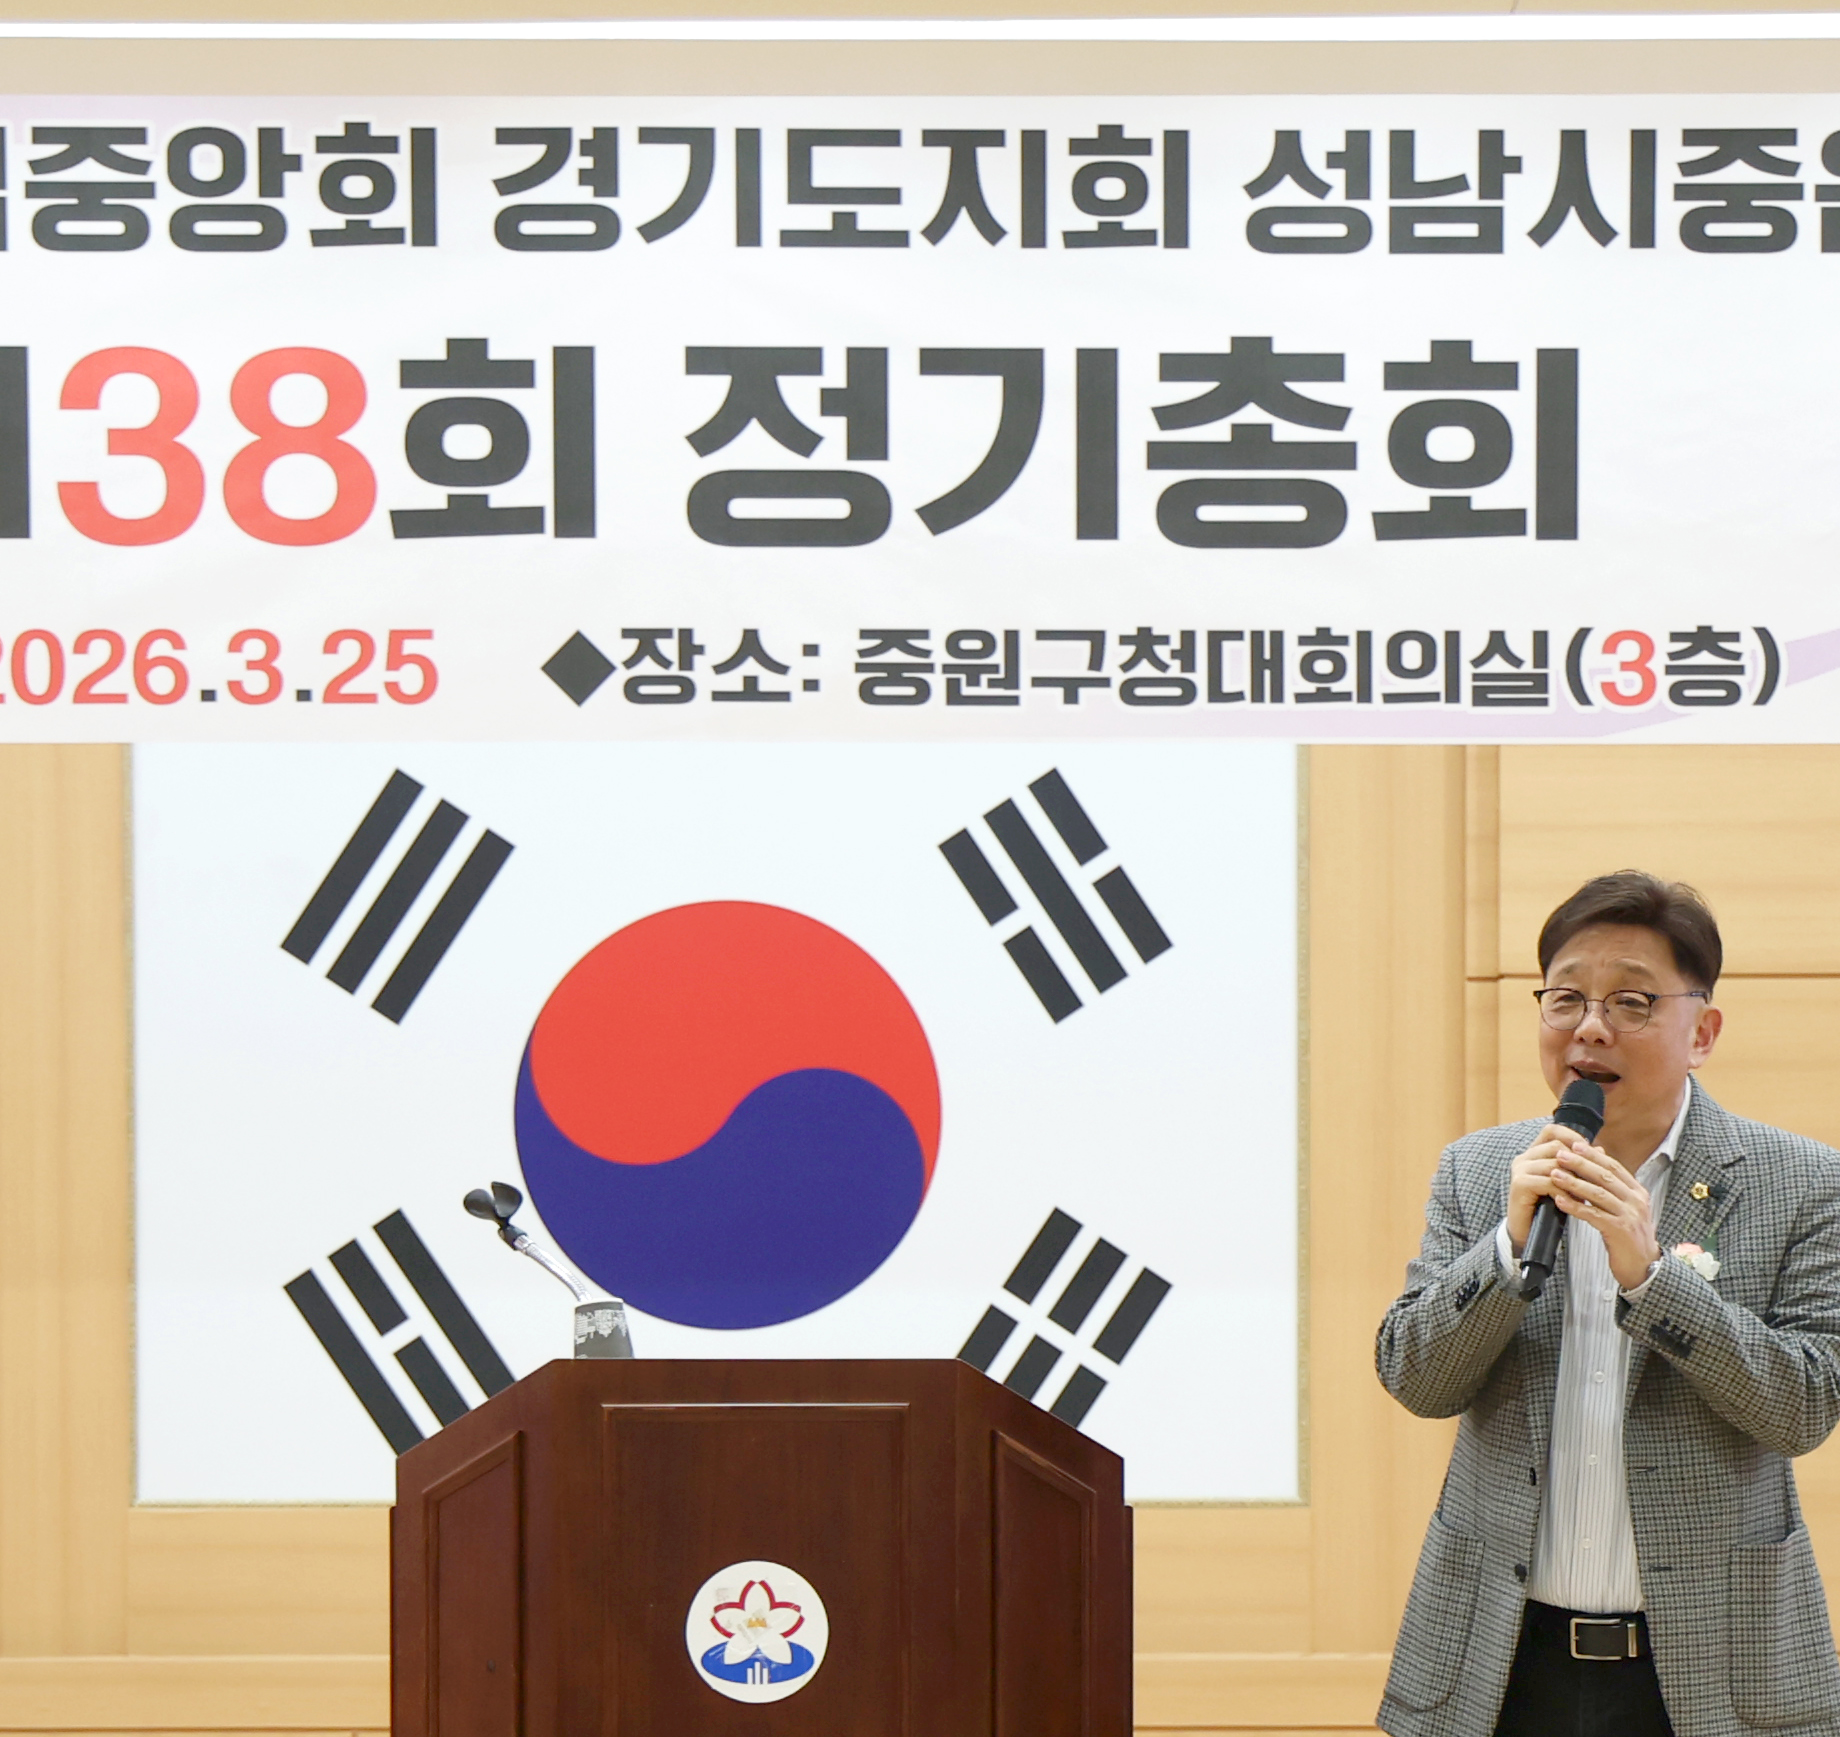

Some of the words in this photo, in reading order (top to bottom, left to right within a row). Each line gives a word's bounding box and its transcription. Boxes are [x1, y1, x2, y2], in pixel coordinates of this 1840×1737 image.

[492, 123, 1190, 253] 경기도지회
[684, 335, 1580, 550] 정기총회
[620, 627, 820, 706] 장소:
[853, 624, 1782, 709] 중원구청대회의실(3층)
